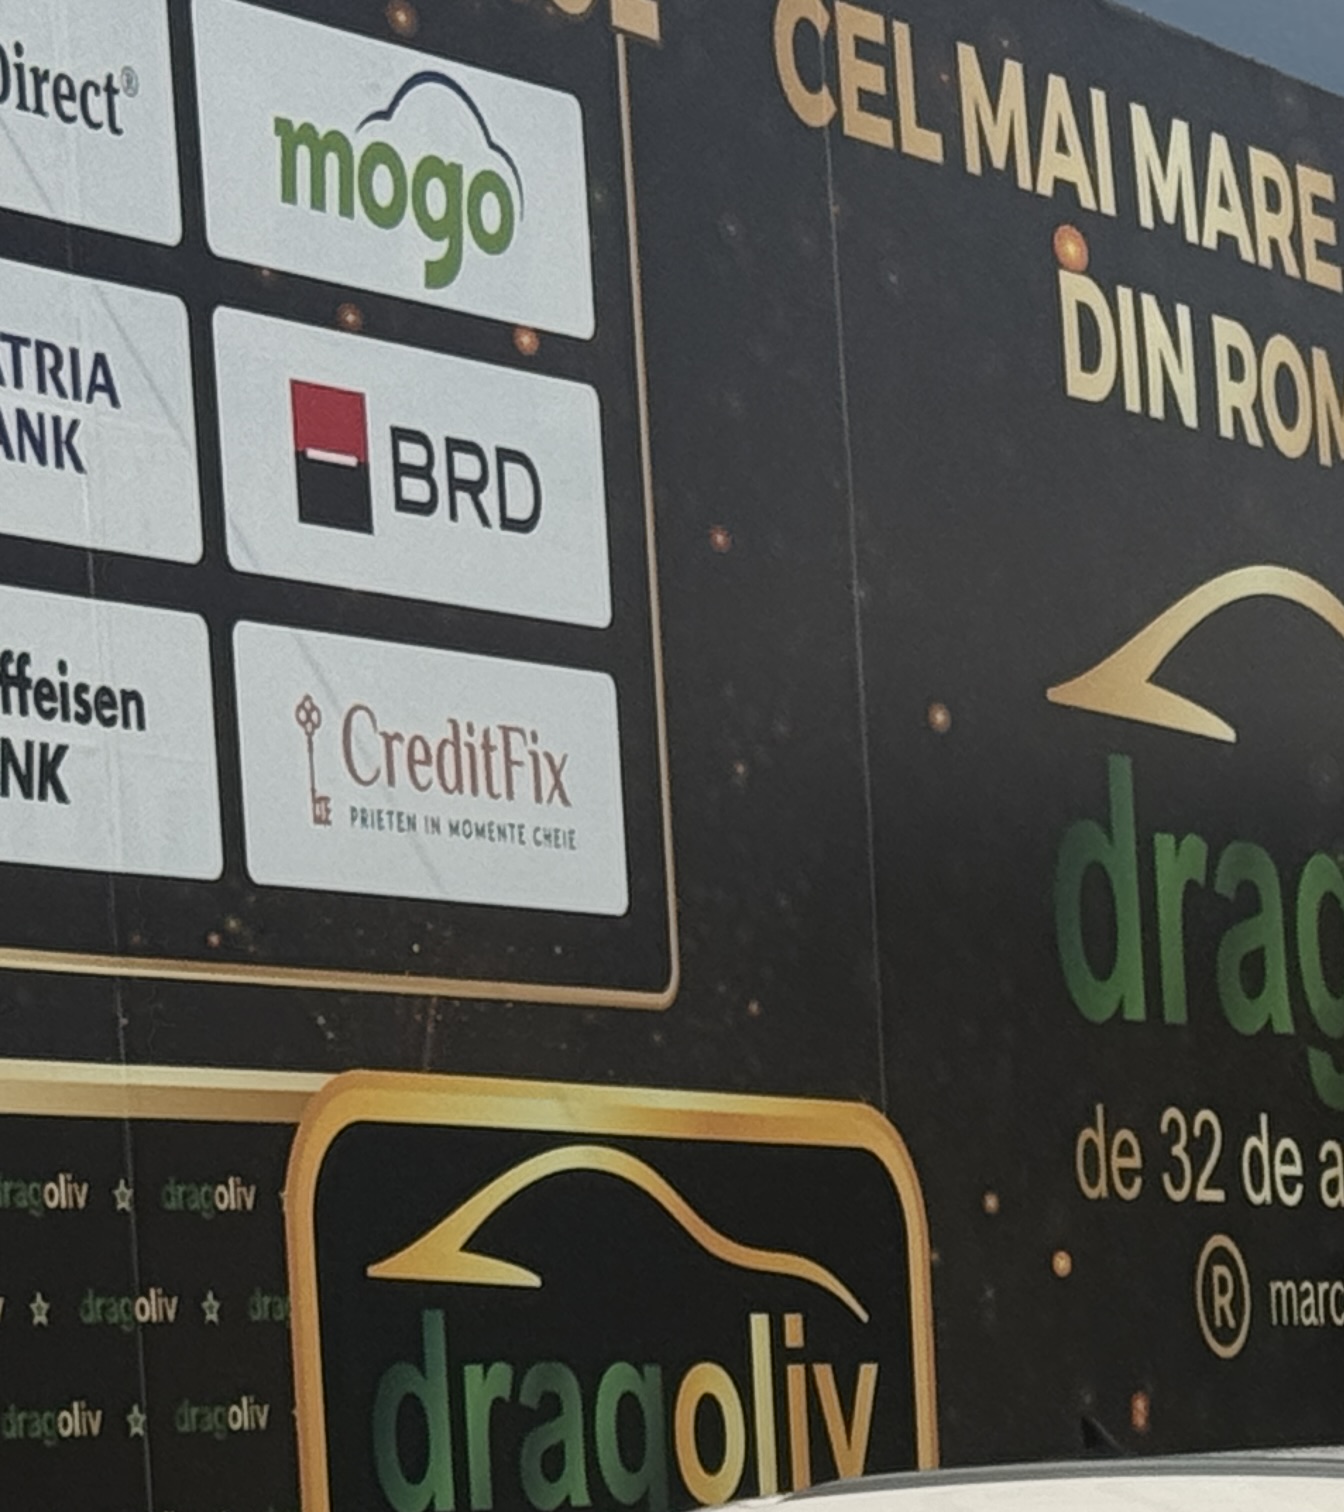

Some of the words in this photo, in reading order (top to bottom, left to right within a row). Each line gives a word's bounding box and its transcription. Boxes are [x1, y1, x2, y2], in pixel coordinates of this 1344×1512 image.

[771, 0, 944, 163] CEL
[956, 41, 1118, 216] MAI
[1129, 102, 1344, 293] MARE
[273, 114, 516, 290] mogo
[0, 332, 121, 410] TRIA
[1057, 268, 1199, 430] DIN
[388, 424, 542, 534] BRD
[342, 703, 573, 808] CreditFix
[349, 805, 418, 833] PRIETEN
[423, 814, 442, 836] IN
[447, 818, 527, 846] MOMENTE
[532, 825, 578, 850] CHEIE
[161, 1176, 257, 1219] dragoliv
[1075, 1103, 1143, 1200] de
[1160, 1106, 1226, 1203] 32
[1241, 1112, 1303, 1207] de
[79, 1287, 179, 1332] dragoliv
[3, 1400, 102, 1446] dragoliv
[174, 1395, 270, 1440] dragoliv
